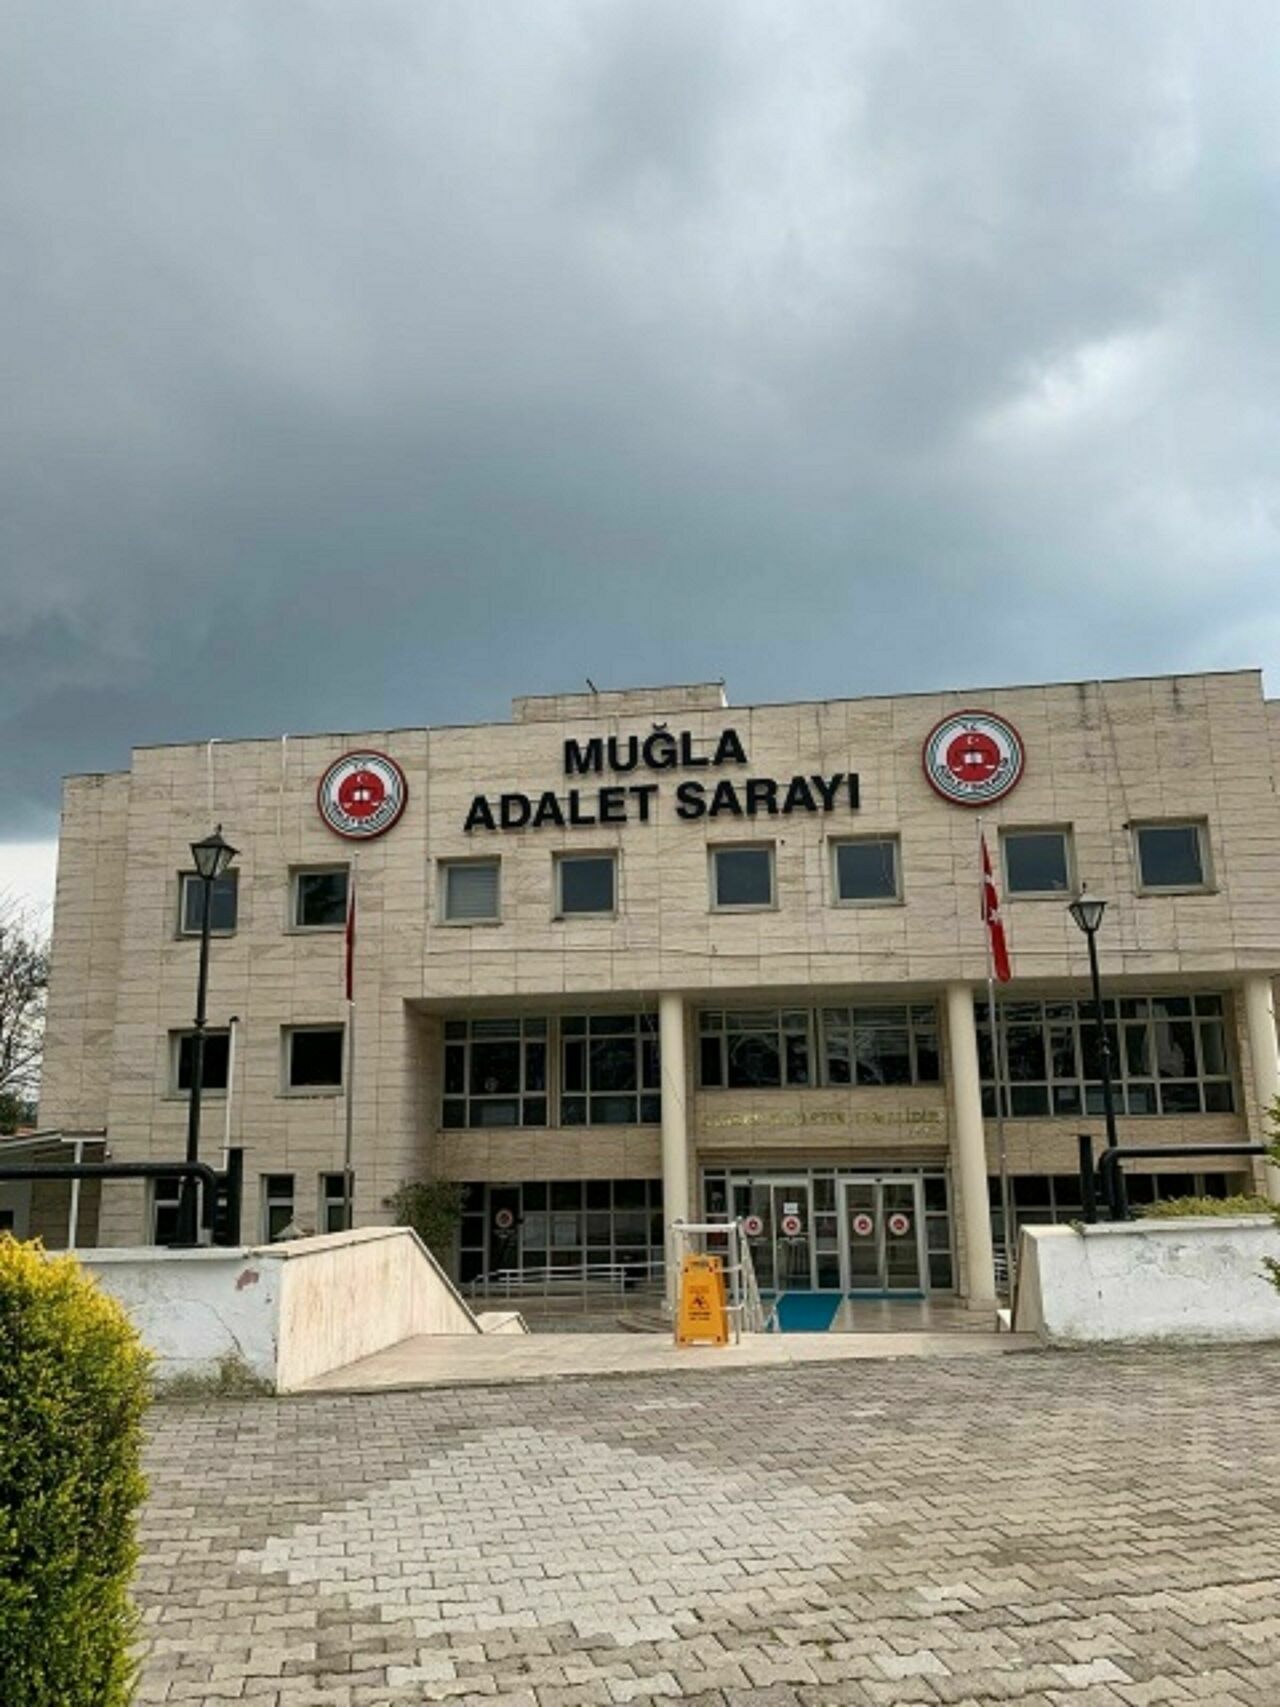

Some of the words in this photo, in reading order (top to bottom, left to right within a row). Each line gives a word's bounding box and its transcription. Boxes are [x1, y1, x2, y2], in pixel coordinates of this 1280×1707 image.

[564, 722, 747, 775] MUĞLA
[463, 784, 659, 832] ADALET
[675, 773, 860, 820] SARAYI
